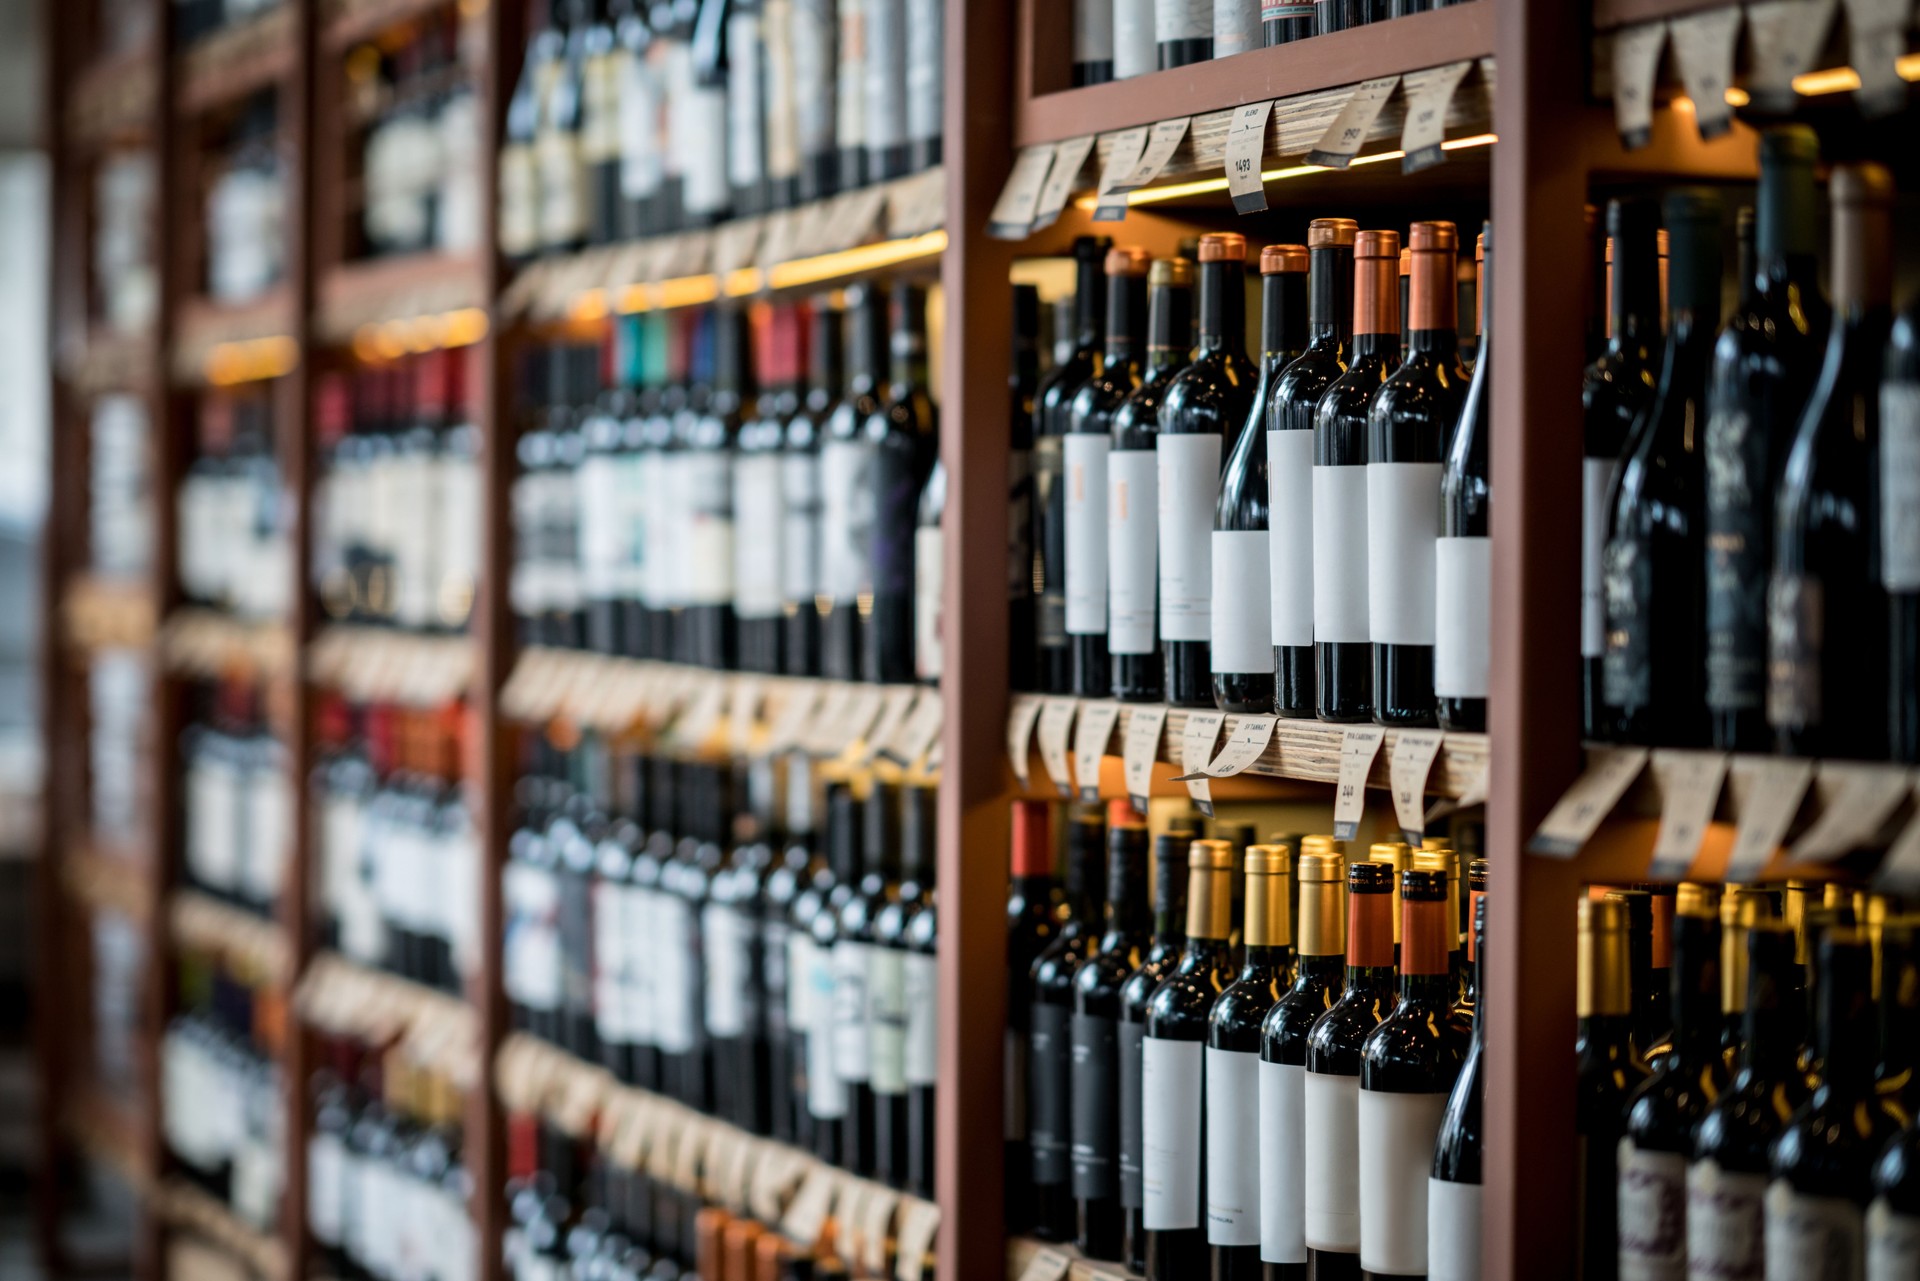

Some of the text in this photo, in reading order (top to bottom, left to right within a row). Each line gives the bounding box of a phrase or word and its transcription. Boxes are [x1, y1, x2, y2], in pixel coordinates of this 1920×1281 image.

[1245, 108, 1259, 118] BLEND
[1235, 158, 1251, 173] 1493
[1250, 723, 1267, 731] TANNAT
[1355, 732, 1377, 742] CABERNET
[1342, 784, 1354, 798] 240
